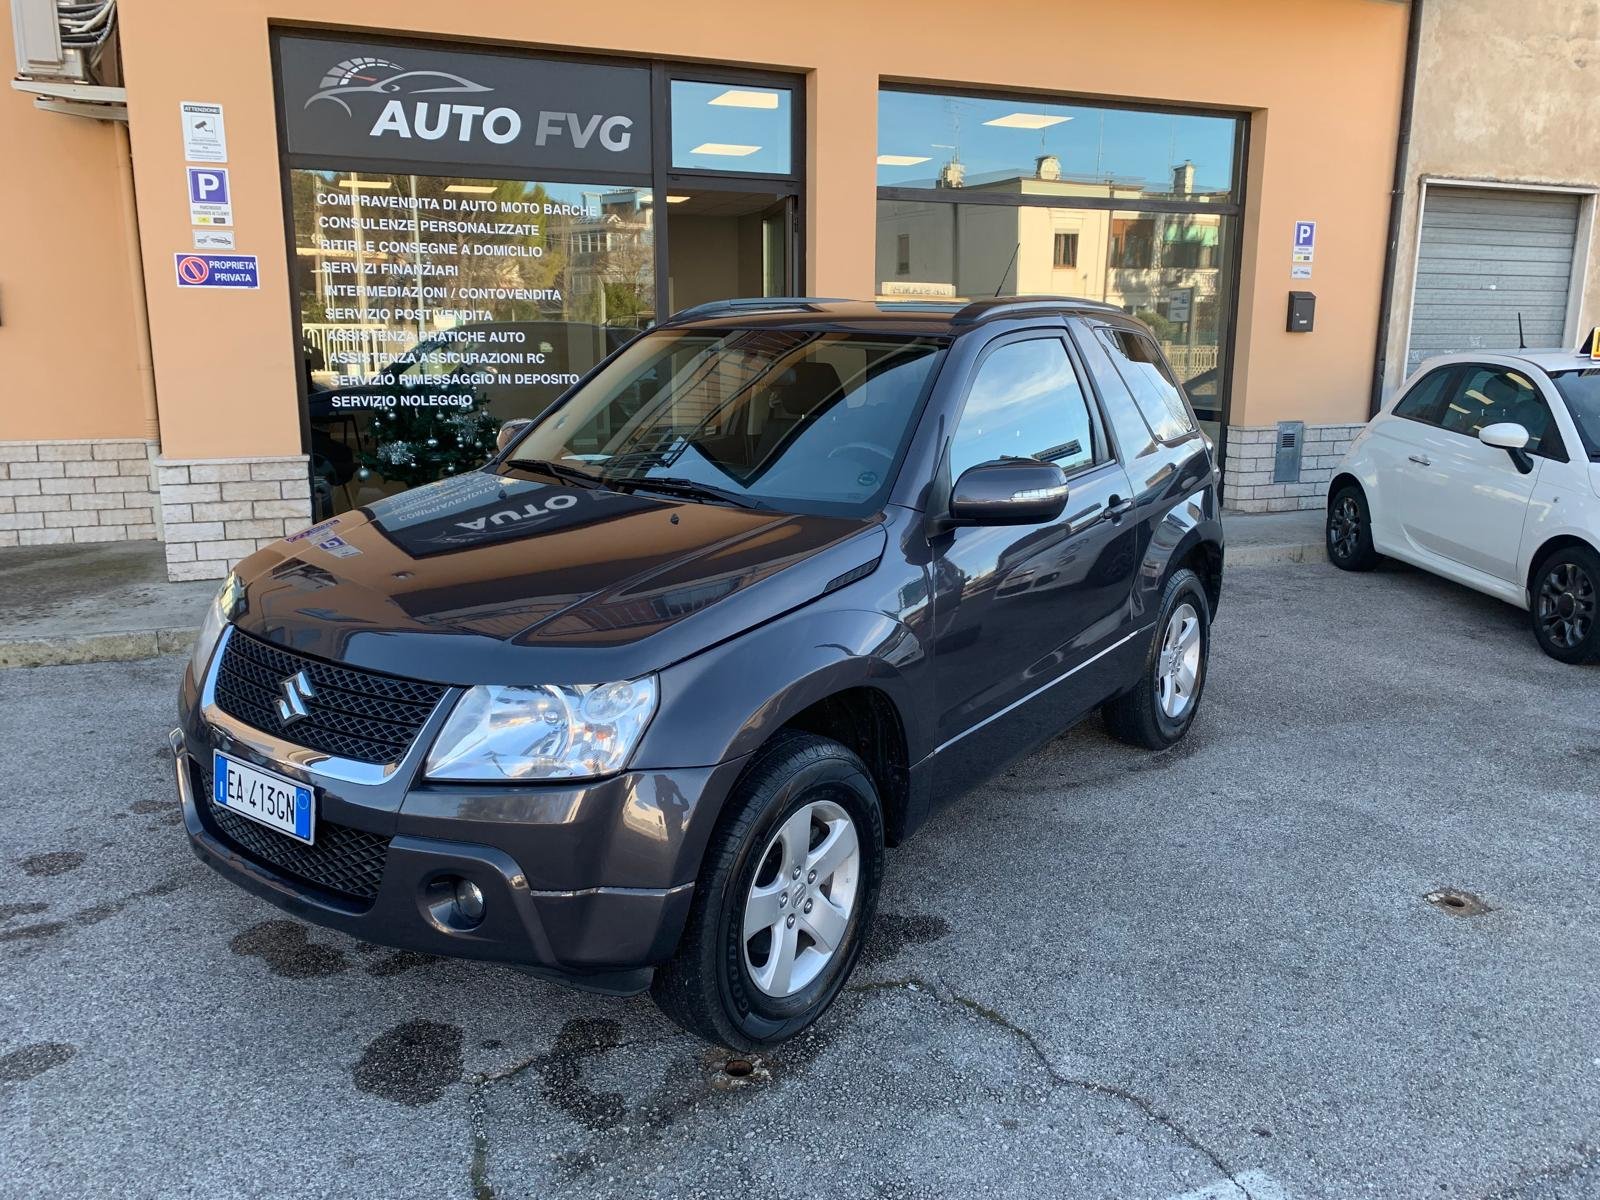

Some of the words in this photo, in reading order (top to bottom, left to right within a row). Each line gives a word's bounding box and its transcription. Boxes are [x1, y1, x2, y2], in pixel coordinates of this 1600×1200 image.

[369, 100, 522, 144] AUTO
[535, 111, 634, 152] FVG
[197, 173, 219, 200] P
[316, 193, 440, 210] COMPRAVENDITA
[442, 199, 458, 211] DI
[459, 200, 498, 213] AUTO
[500, 202, 541, 215] MOTO
[543, 203, 598, 217] BARCHE
[318, 216, 418, 232] CONSULENZE
[420, 220, 540, 236] PERSONALIZZATE
[1299, 225, 1311, 244] P
[366, 241, 375, 253] E
[378, 242, 457, 255] CONSEGNE
[460, 244, 471, 256] A
[473, 244, 543, 258] DOMICILIO
[209, 260, 256, 270] PROPRIETA'
[321, 262, 377, 275] SERVIZI
[380, 263, 459, 277] FINANZIARI
[214, 272, 252, 282] PRIVATA
[325, 284, 447, 299] INTERMEDIAZIONI
[459, 287, 562, 301] CONTOVENDITA
[325, 308, 390, 321] SERVIZIO
[394, 308, 432, 321] POST
[436, 309, 493, 322] VENDITA
[327, 331, 415, 343] ASSISTENZA
[418, 331, 486, 343] PRATICHE
[489, 331, 526, 344] AUTO
[329, 352, 417, 365] ASSISTENZA
[420, 352, 524, 365] ASSICURAZIONI
[527, 352, 545, 365] RC
[331, 374, 396, 386] SERVIZIO
[399, 373, 495, 386] RIMESSAGGIO
[498, 373, 512, 385] IN
[515, 373, 580, 386] DEPOSITO
[331, 395, 397, 408] SERVIZIO
[400, 395, 473, 408] NOLEGGIO
[228, 769, 244, 803] EA
[249, 780, 295, 825] 413GN
